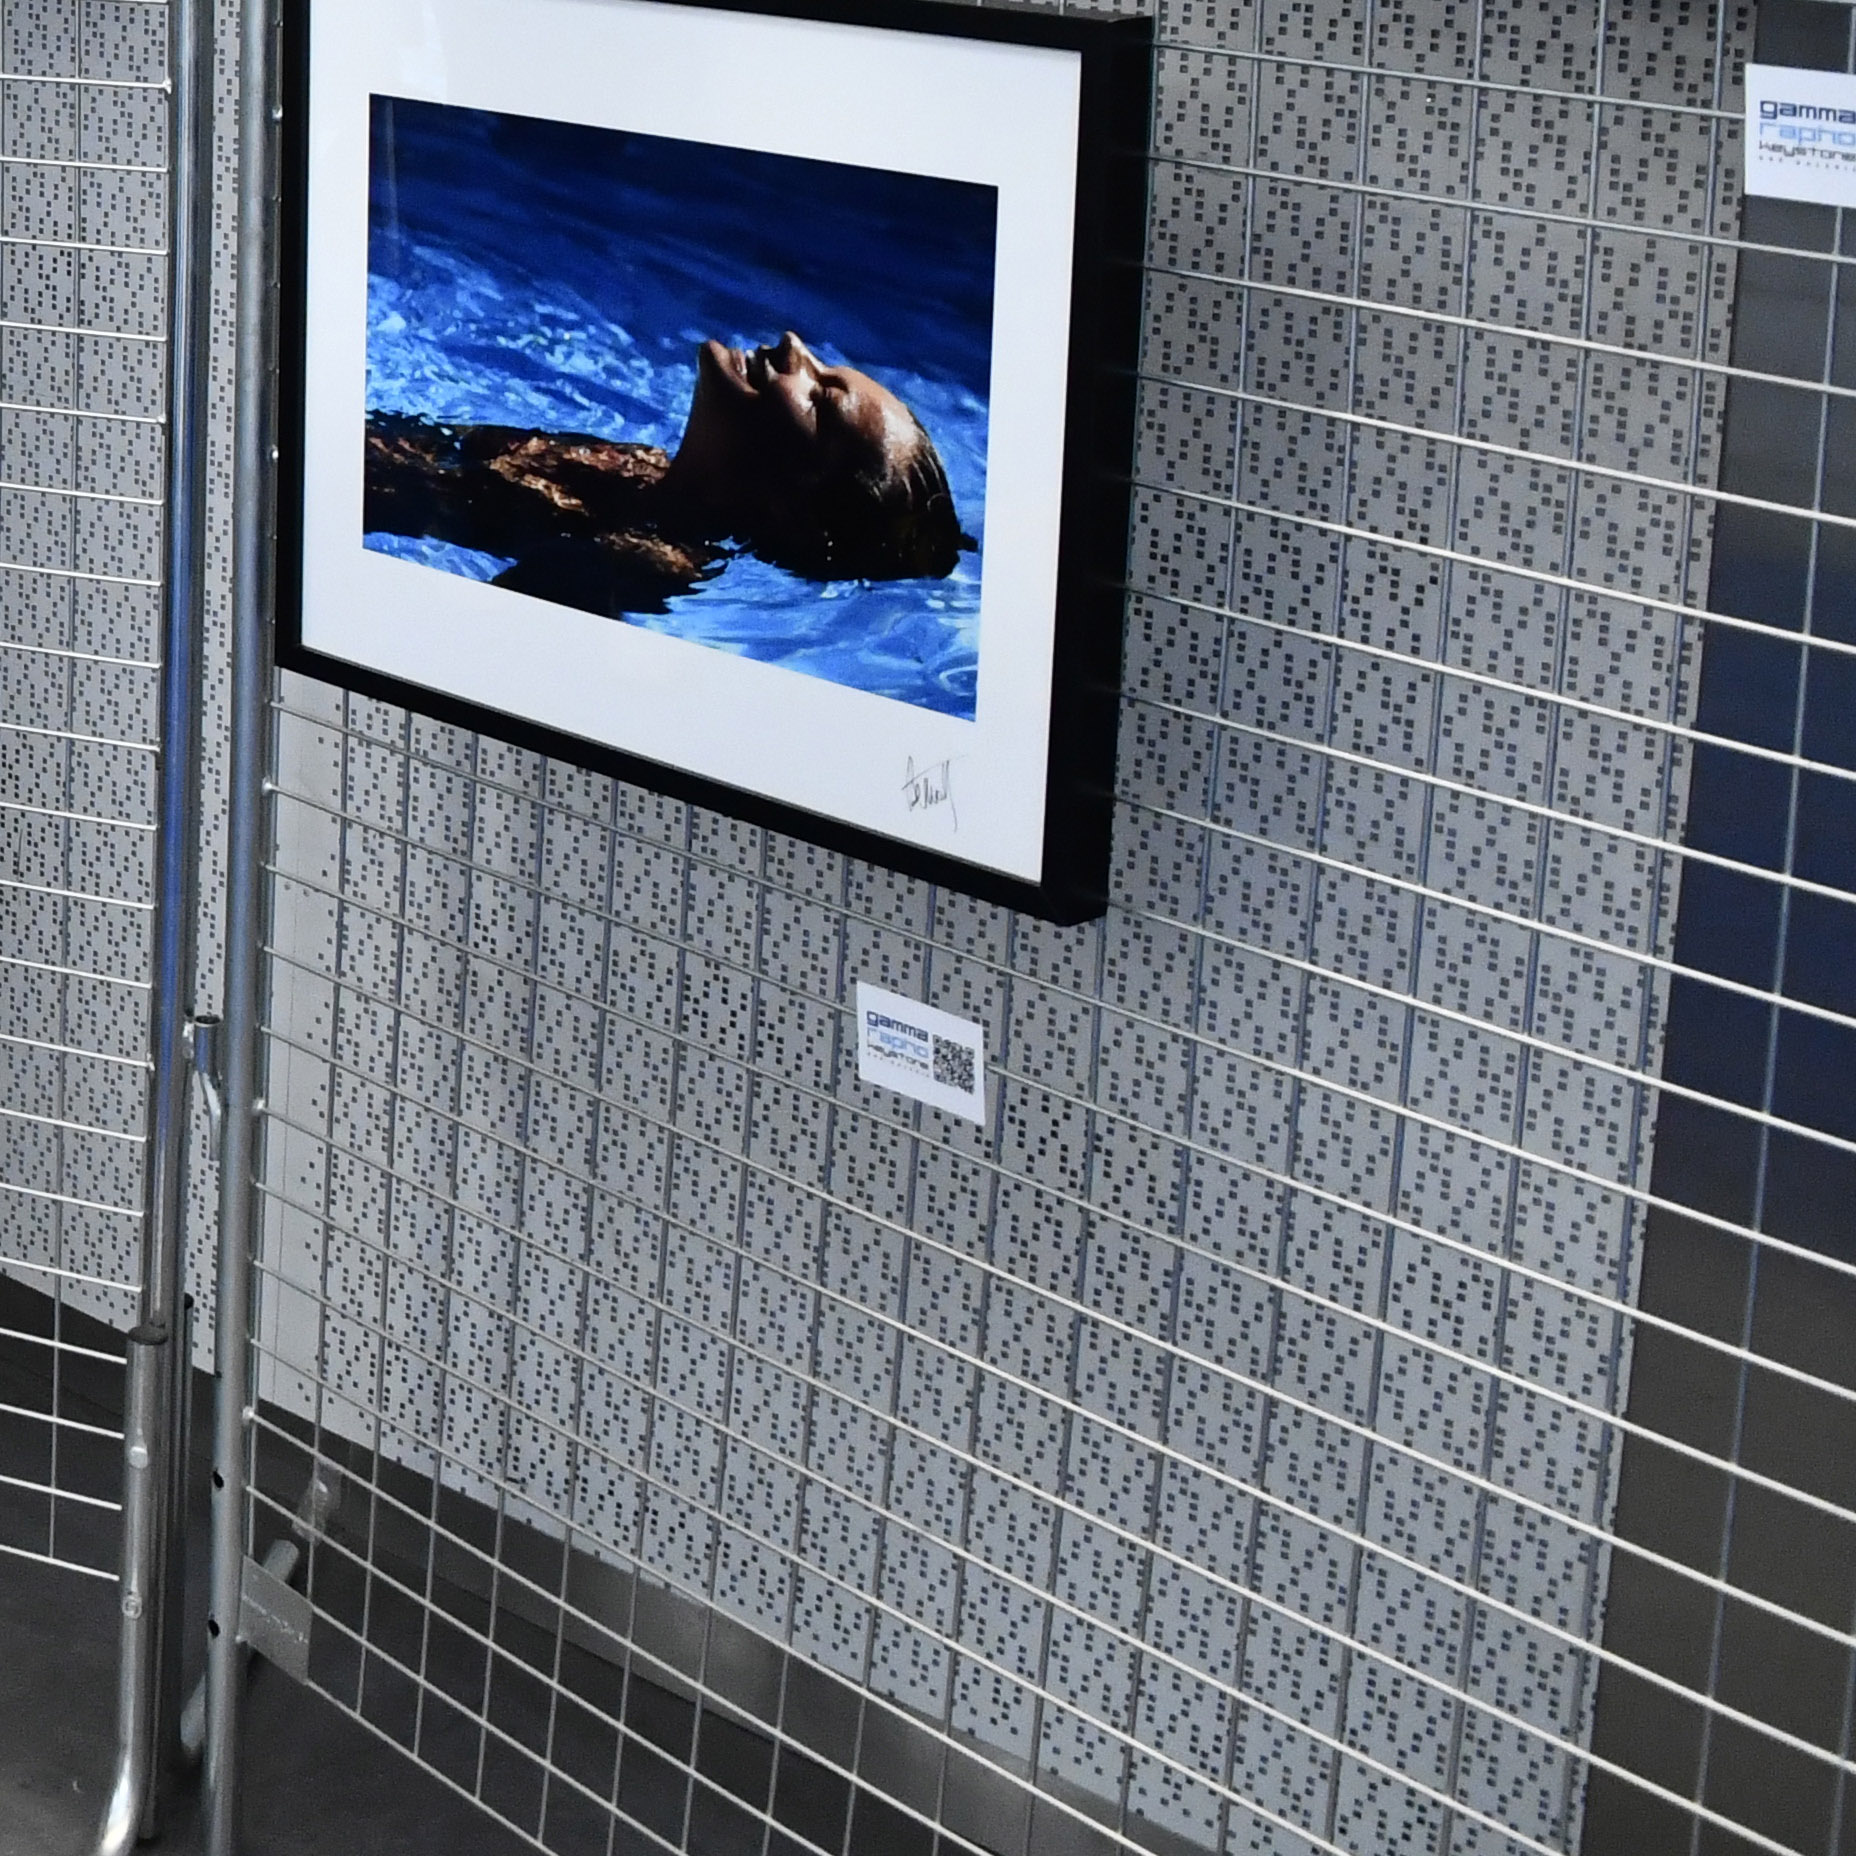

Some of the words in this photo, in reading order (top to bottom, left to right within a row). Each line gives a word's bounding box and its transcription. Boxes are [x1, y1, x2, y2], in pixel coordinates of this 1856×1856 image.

[1760, 100, 1856, 124] gamma
[1760, 123, 1856, 146] rapho
[1759, 140, 1856, 162] keystone
[866, 1010, 929, 1042] gamma
